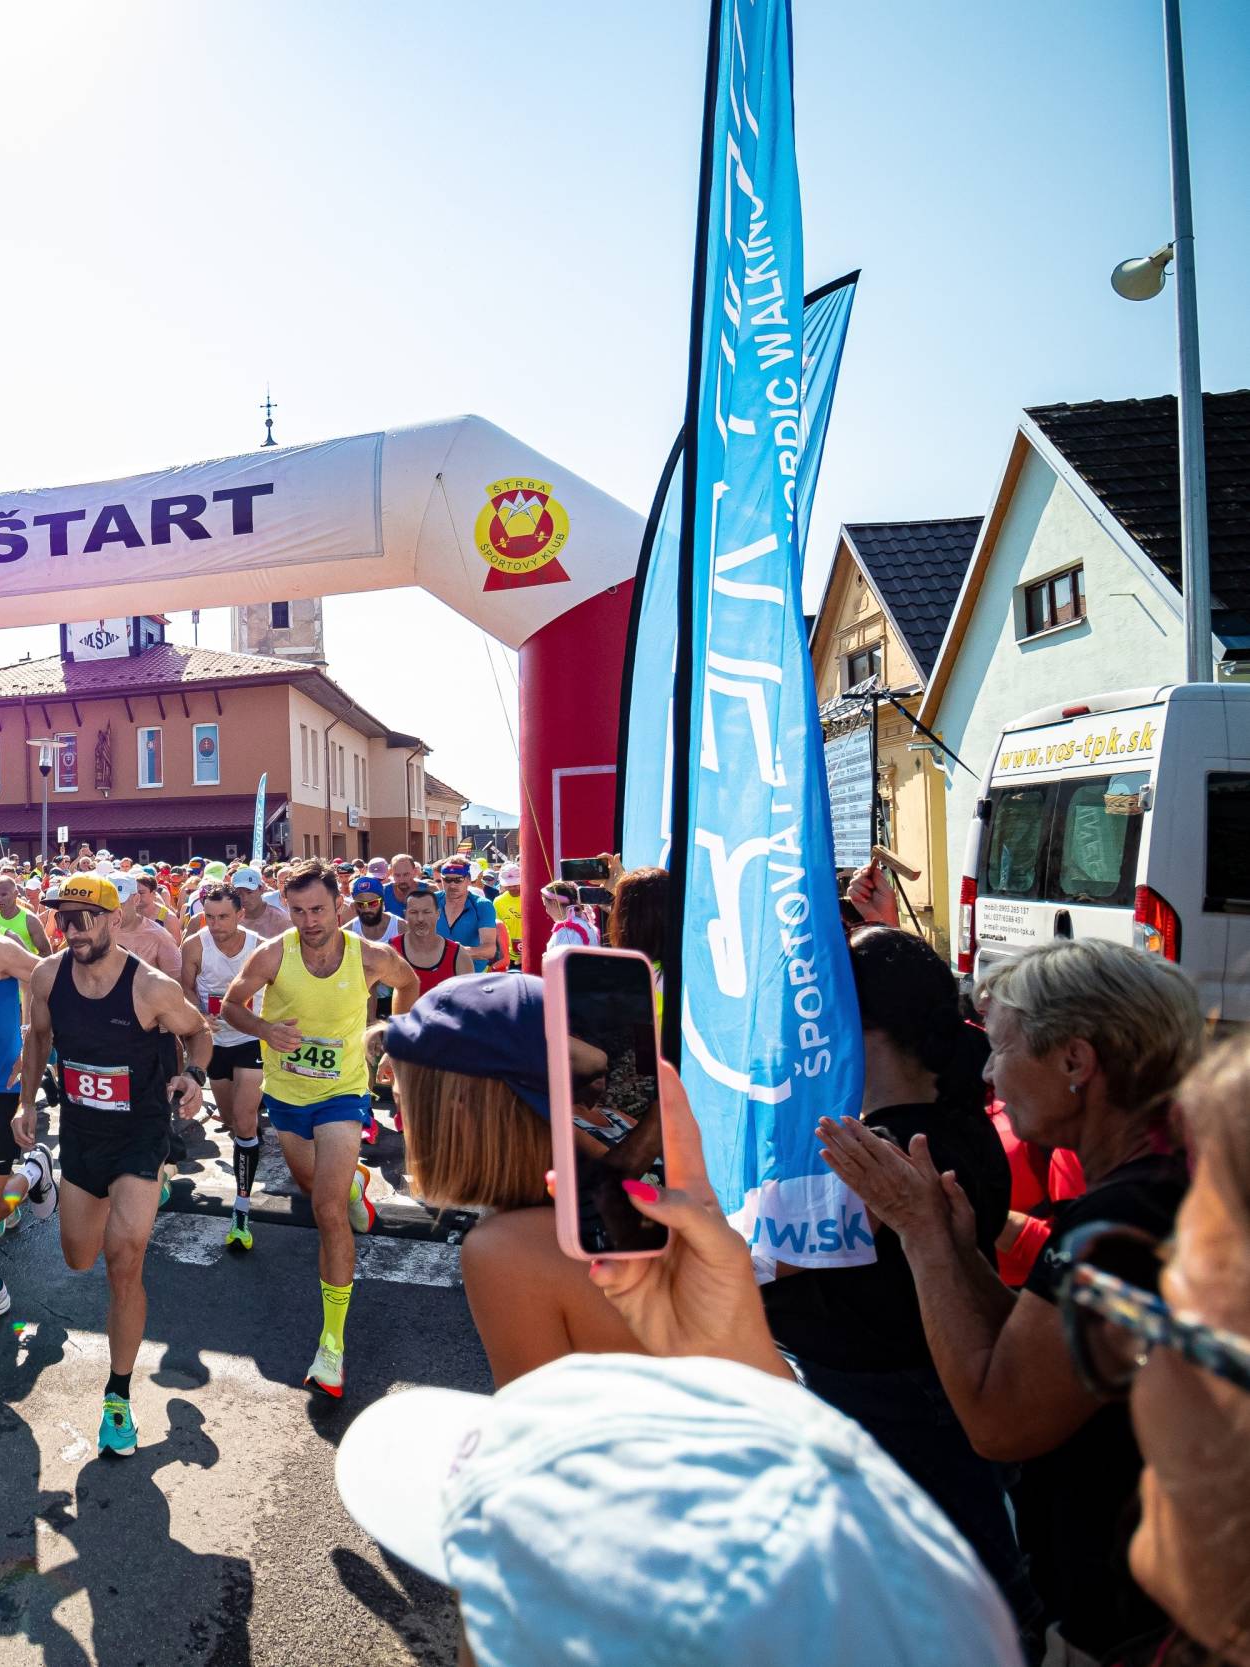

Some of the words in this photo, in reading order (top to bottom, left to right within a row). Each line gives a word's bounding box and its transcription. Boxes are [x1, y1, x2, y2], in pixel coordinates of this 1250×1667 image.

[542, 533, 565, 560] KLUB
[1000, 722, 1156, 770] www.vos-tpk.sk
[79, 1074, 113, 1100] 85
